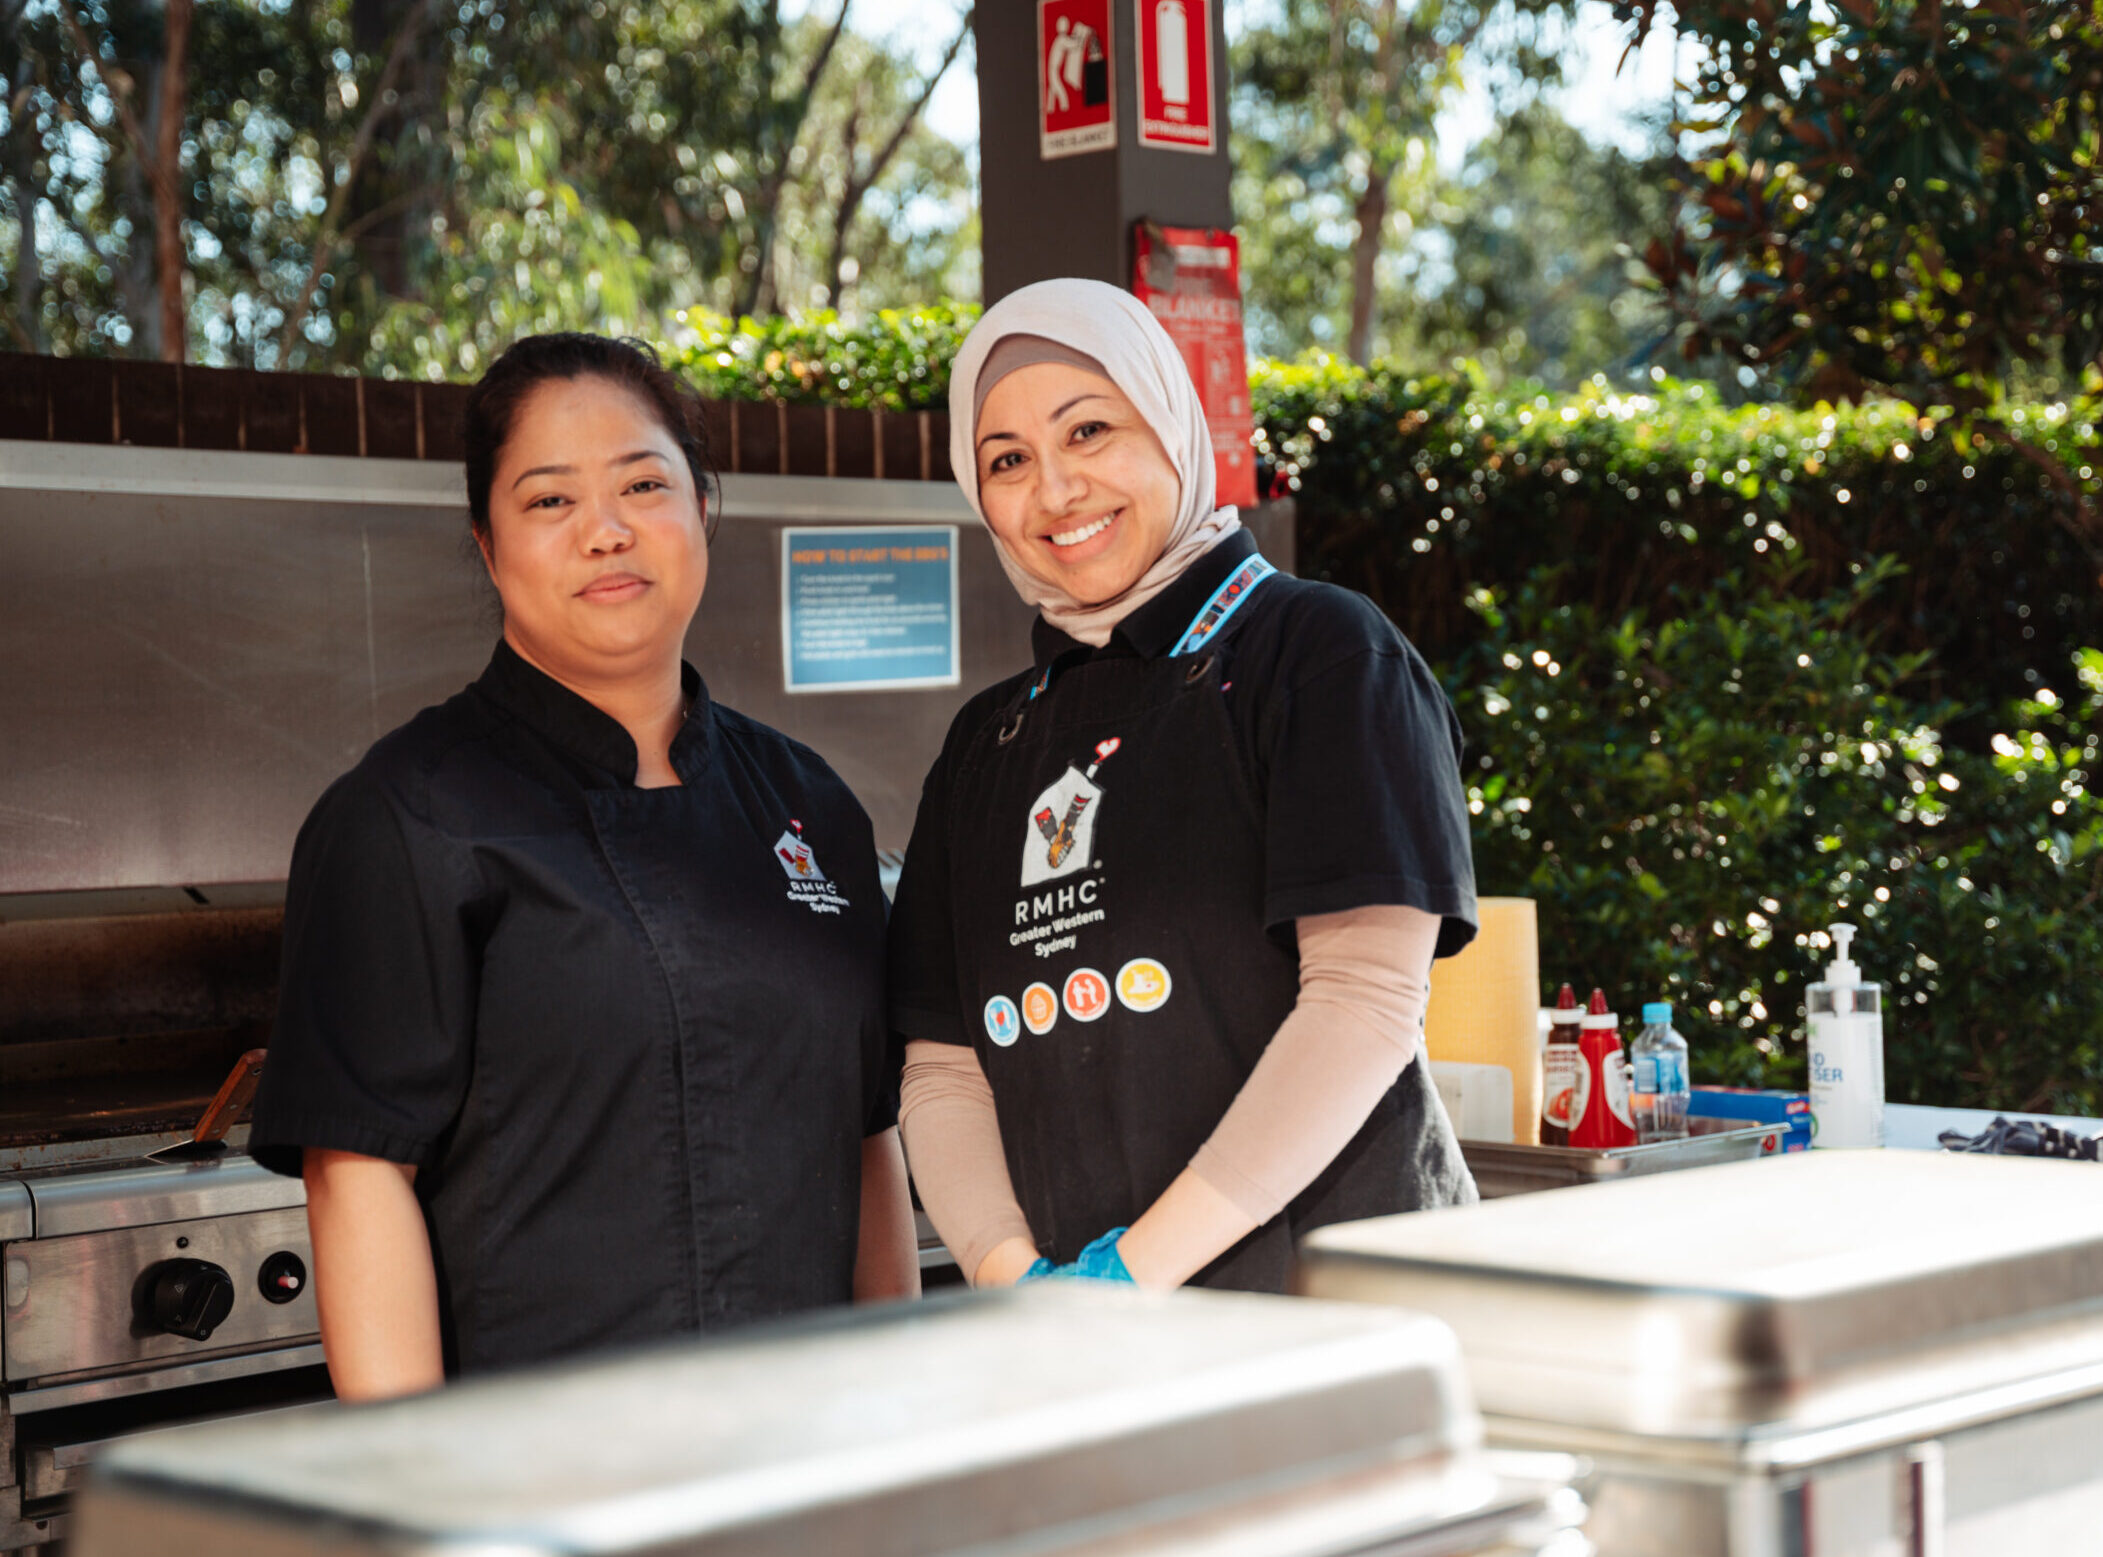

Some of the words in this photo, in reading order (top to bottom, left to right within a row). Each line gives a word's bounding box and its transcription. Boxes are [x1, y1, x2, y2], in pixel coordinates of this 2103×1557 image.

[792, 549, 826, 564] HOW
[829, 548, 847, 564] TO
[848, 547, 888, 564] START
[890, 547, 913, 562] THE
[790, 881, 837, 895] RMHC
[1015, 879, 1098, 926] RMHC
[1009, 925, 1052, 947] Greater
[1051, 909, 1106, 934] Western
[1034, 934, 1077, 959] Sydney
